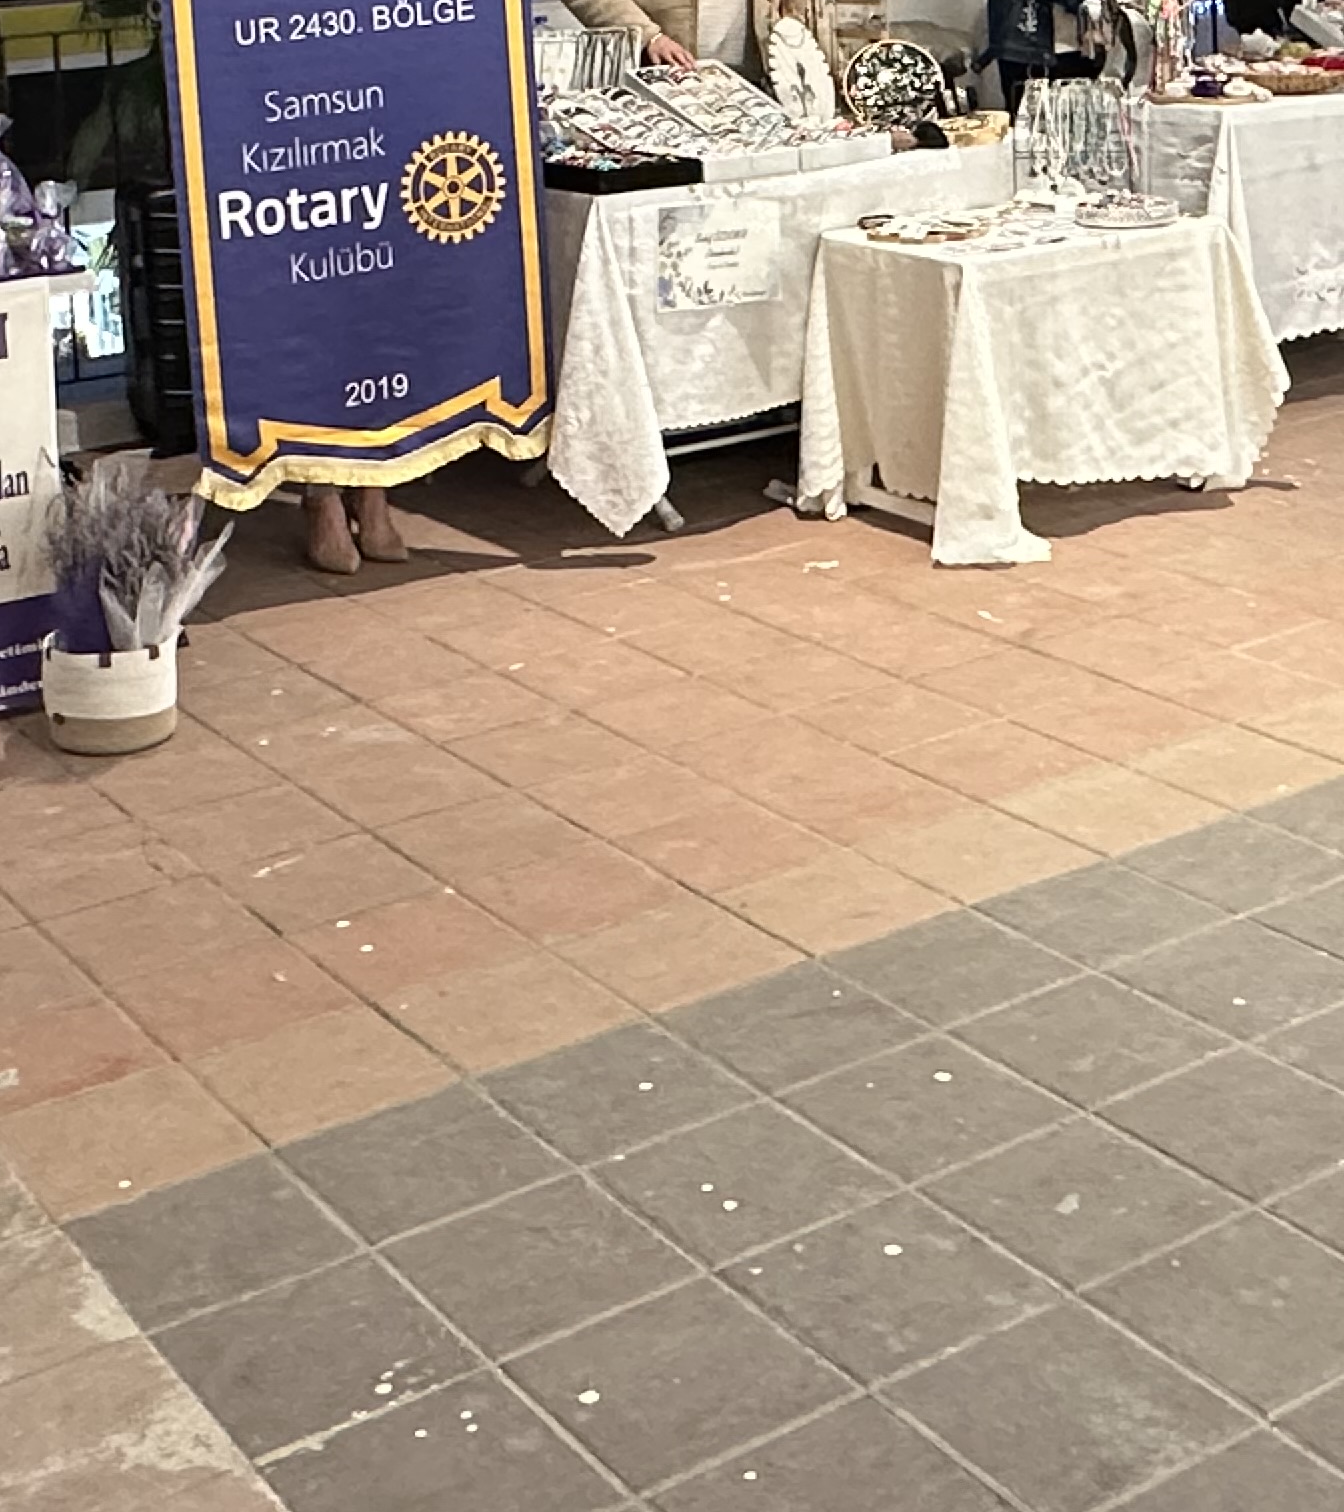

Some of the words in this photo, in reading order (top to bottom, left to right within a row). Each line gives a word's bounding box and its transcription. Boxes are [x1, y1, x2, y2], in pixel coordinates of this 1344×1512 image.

[234, 16, 282, 46] UR
[289, 8, 364, 40] 2430.
[264, 85, 384, 123] Samsun
[242, 126, 386, 175] Kızılırmak
[218, 181, 390, 240] Rotary
[289, 241, 394, 284] Kulübü
[344, 372, 408, 407] 2019
